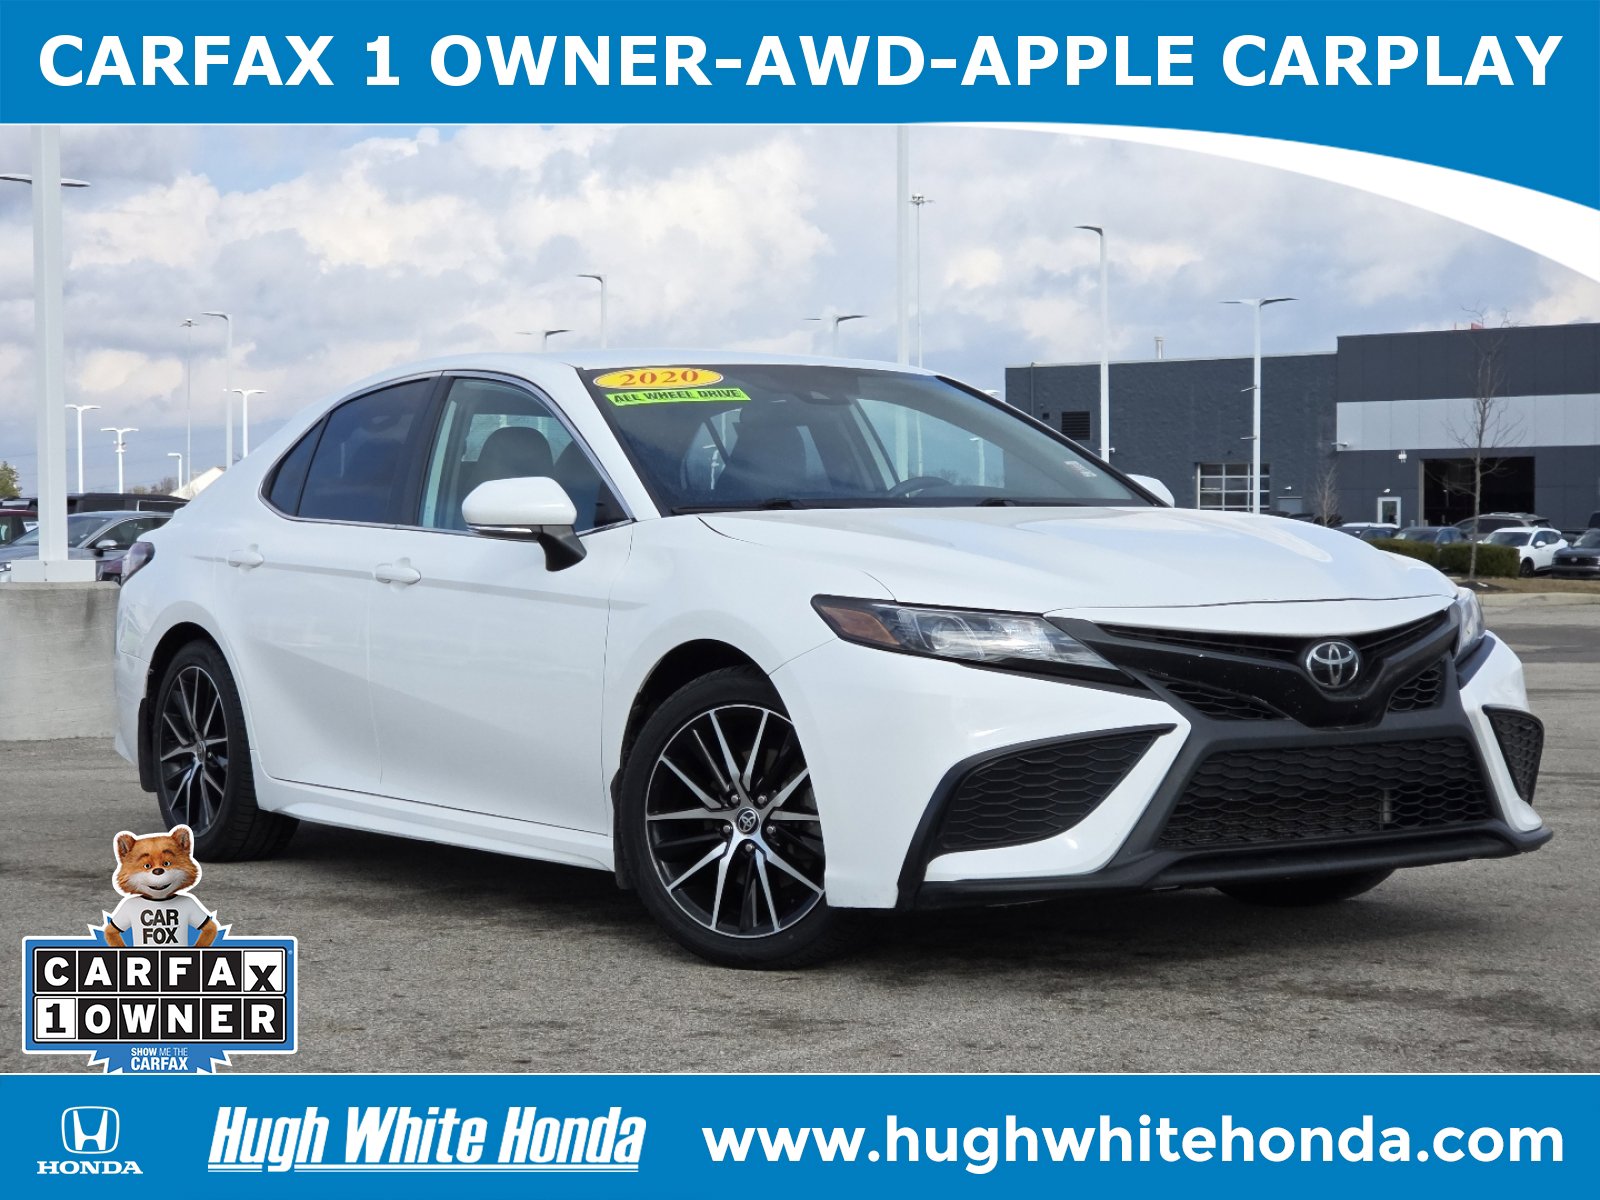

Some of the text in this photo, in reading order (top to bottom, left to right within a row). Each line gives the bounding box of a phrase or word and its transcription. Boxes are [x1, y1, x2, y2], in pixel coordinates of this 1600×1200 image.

[620, 370, 698, 386] 2020
[614, 389, 741, 403] ALL WHEEL DRIVE
